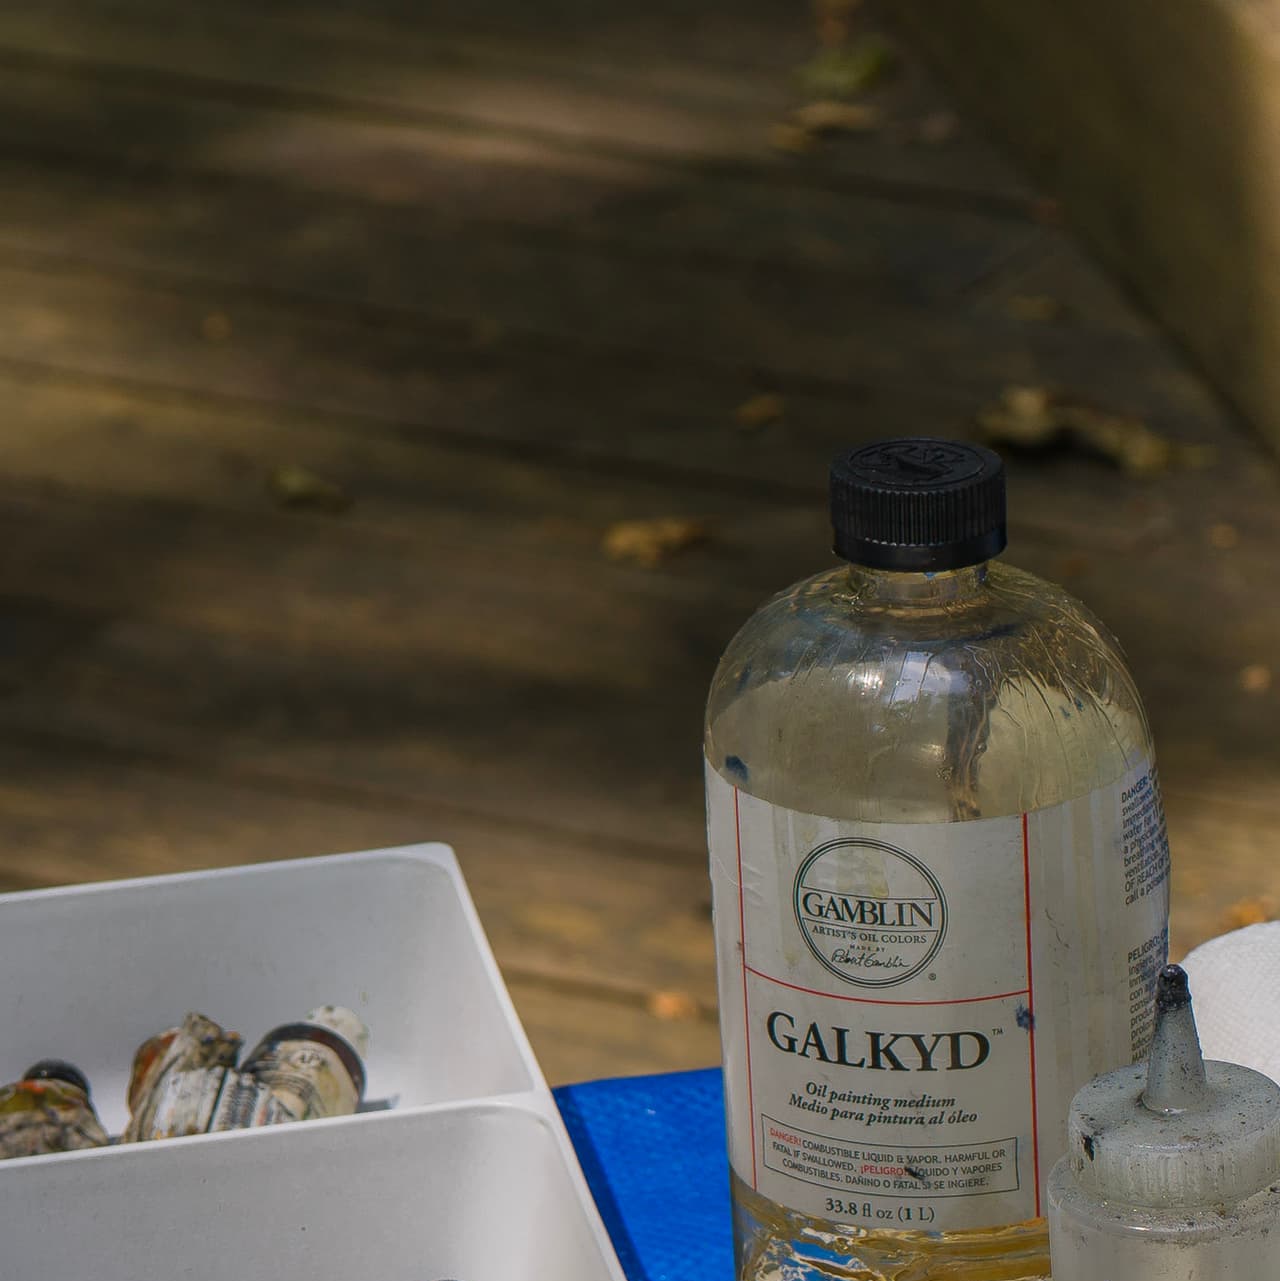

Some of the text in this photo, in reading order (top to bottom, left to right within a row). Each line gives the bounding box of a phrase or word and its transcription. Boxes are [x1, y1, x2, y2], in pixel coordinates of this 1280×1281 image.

[802, 891, 935, 927] GAMBLIN
[812, 925, 927, 944] ARTIST'S OIL COLORS
[789, 1094, 977, 1126] Medio para pintura al óleo
[806, 1081, 956, 1110] Oil painting medium
[770, 1127, 1006, 1164] DANGER! COMBUSTIBLE LIQUID VAPOR. HARMFUL OR
[772, 1142, 857, 1172] FATAL IF SWALLOWED.
[782, 1158, 989, 1190] COMBUSTIBLES. DAÑINO O FATAL SE INGIERE.
[952, 1166, 959, 1176] Y
[961, 1162, 1003, 1175] VAPORES
[825, 1198, 935, 1222] 33.8 fl oz (1 L)
